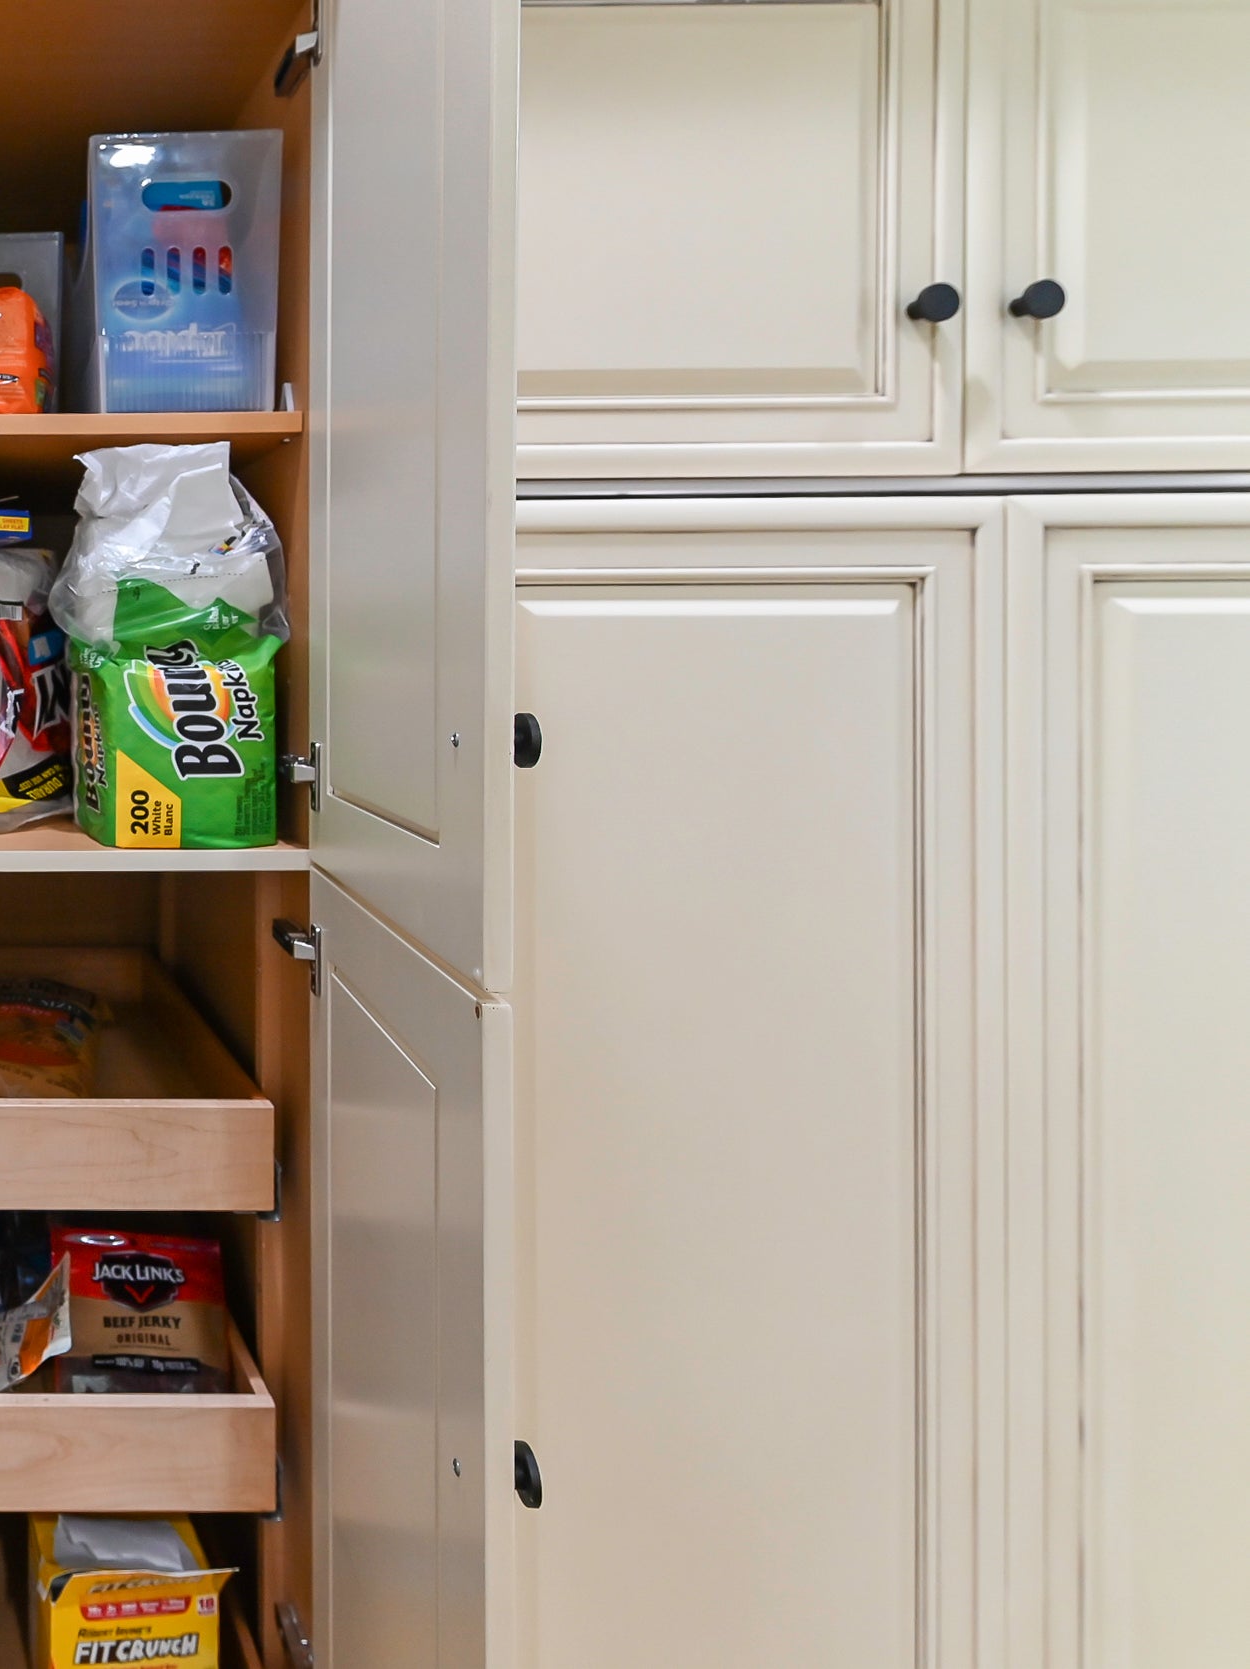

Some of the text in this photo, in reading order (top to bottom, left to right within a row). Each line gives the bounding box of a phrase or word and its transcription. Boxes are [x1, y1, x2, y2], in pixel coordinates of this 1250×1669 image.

[131, 790, 150, 835] 200
[152, 800, 162, 836] White
[164, 803, 174, 836] Blanc
[92, 1262, 133, 1281] JACK
[103, 1316, 182, 1329] BEEF JERKY
[116, 1333, 171, 1346] ORIGINAL
